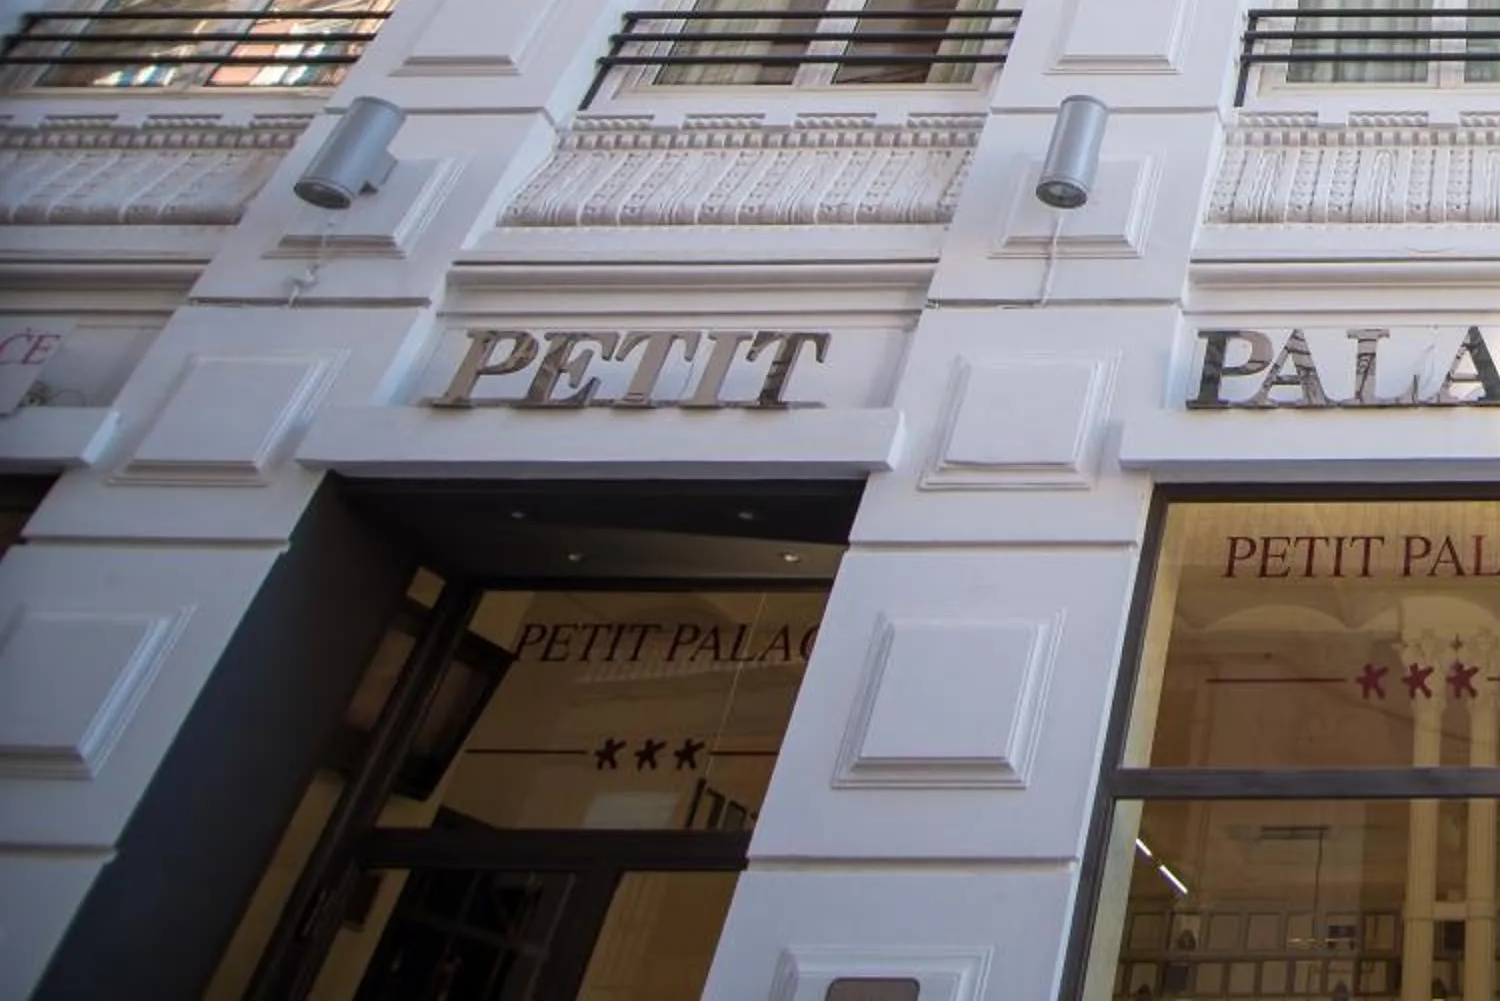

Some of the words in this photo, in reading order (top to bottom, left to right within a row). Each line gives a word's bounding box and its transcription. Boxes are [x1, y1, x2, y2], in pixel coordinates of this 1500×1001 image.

[430, 329, 832, 409] PETIT
[1221, 535, 1385, 579] PETIT
[513, 622, 661, 662] PETIT
